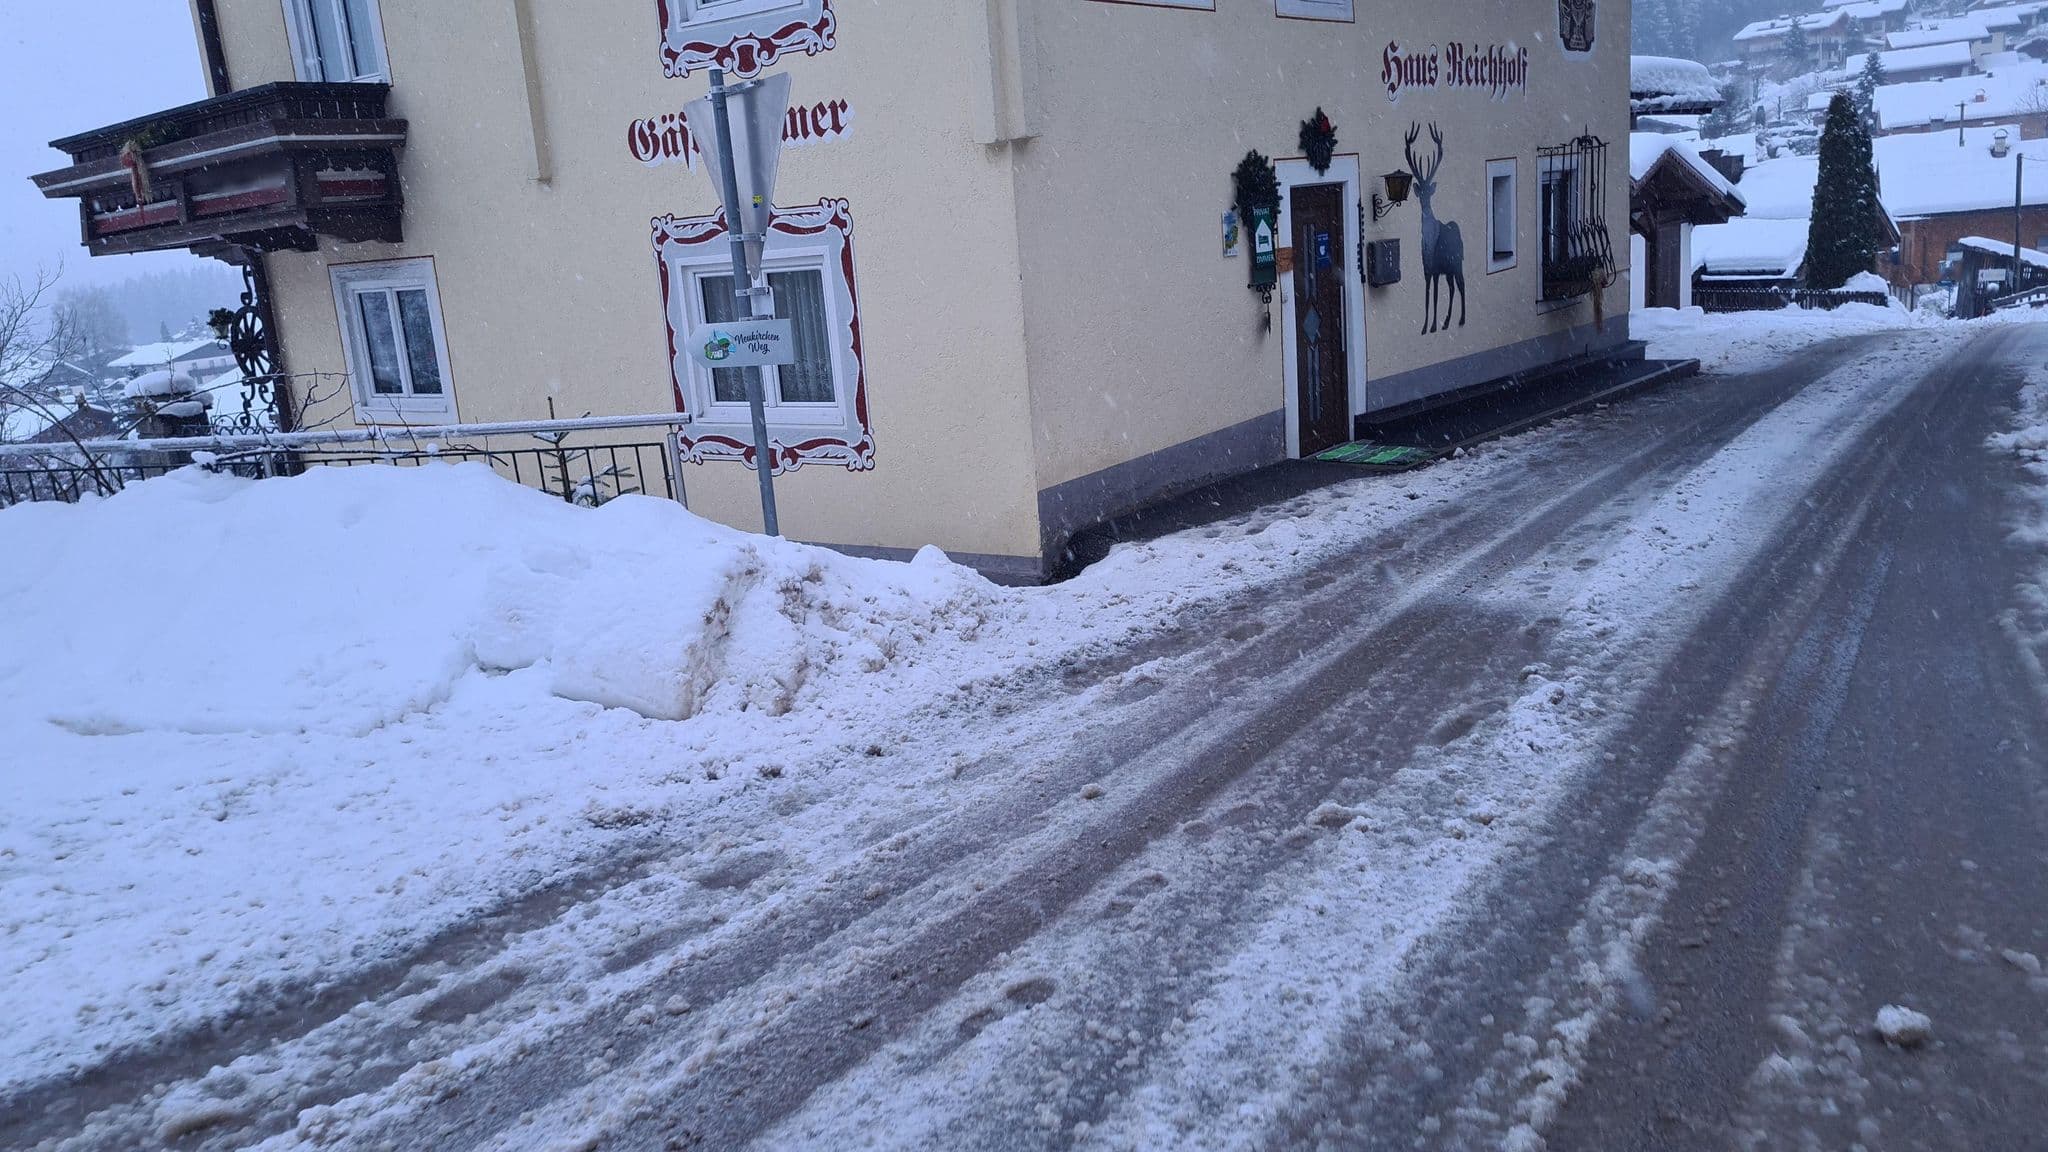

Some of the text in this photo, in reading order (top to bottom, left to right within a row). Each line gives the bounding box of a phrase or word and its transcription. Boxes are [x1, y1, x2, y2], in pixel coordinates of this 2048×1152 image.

[1381, 40, 1528, 101] Haus Reichholf
[734, 330, 780, 345] Neukirchen
[748, 341, 770, 355] Weg
